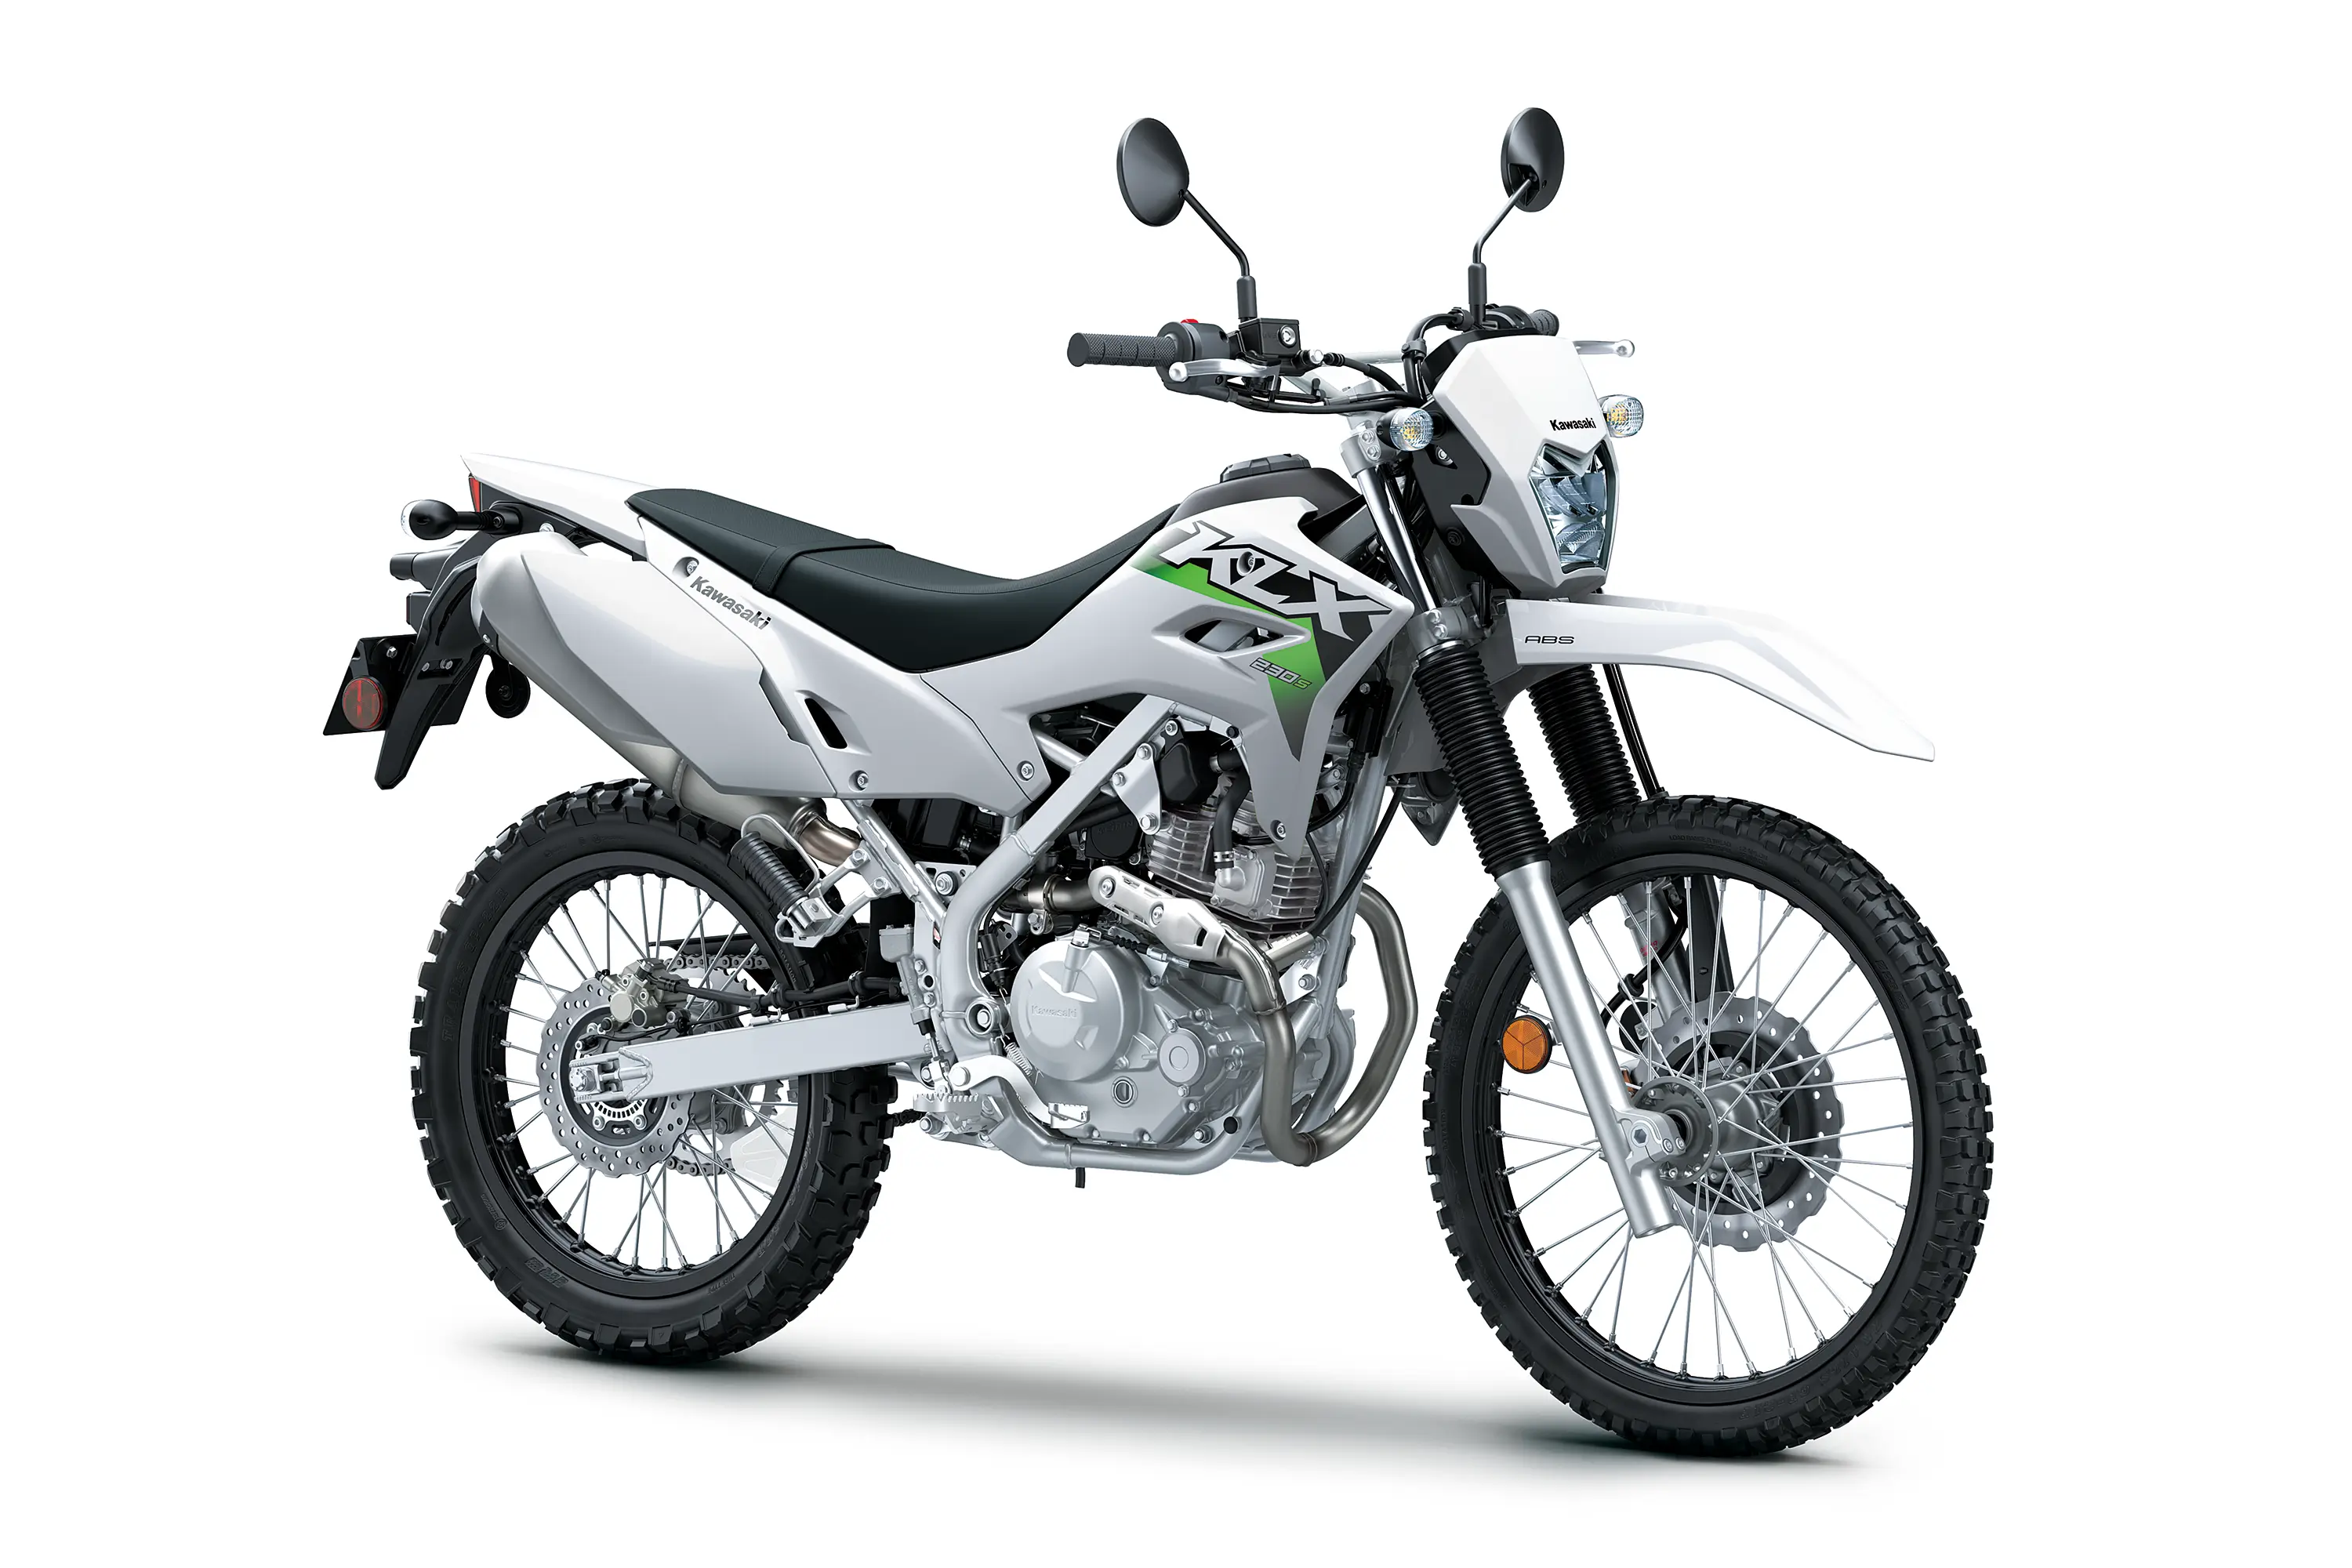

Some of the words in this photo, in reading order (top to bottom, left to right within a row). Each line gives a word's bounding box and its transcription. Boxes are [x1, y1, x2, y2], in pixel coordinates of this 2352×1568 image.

[1549, 418, 1596, 431] Kawasaki
[1159, 520, 1392, 641] KLX
[690, 575, 771, 630] Kawasaki
[1525, 635, 1574, 644] ABS
[1031, 1004, 1078, 1018] Kawasaki
